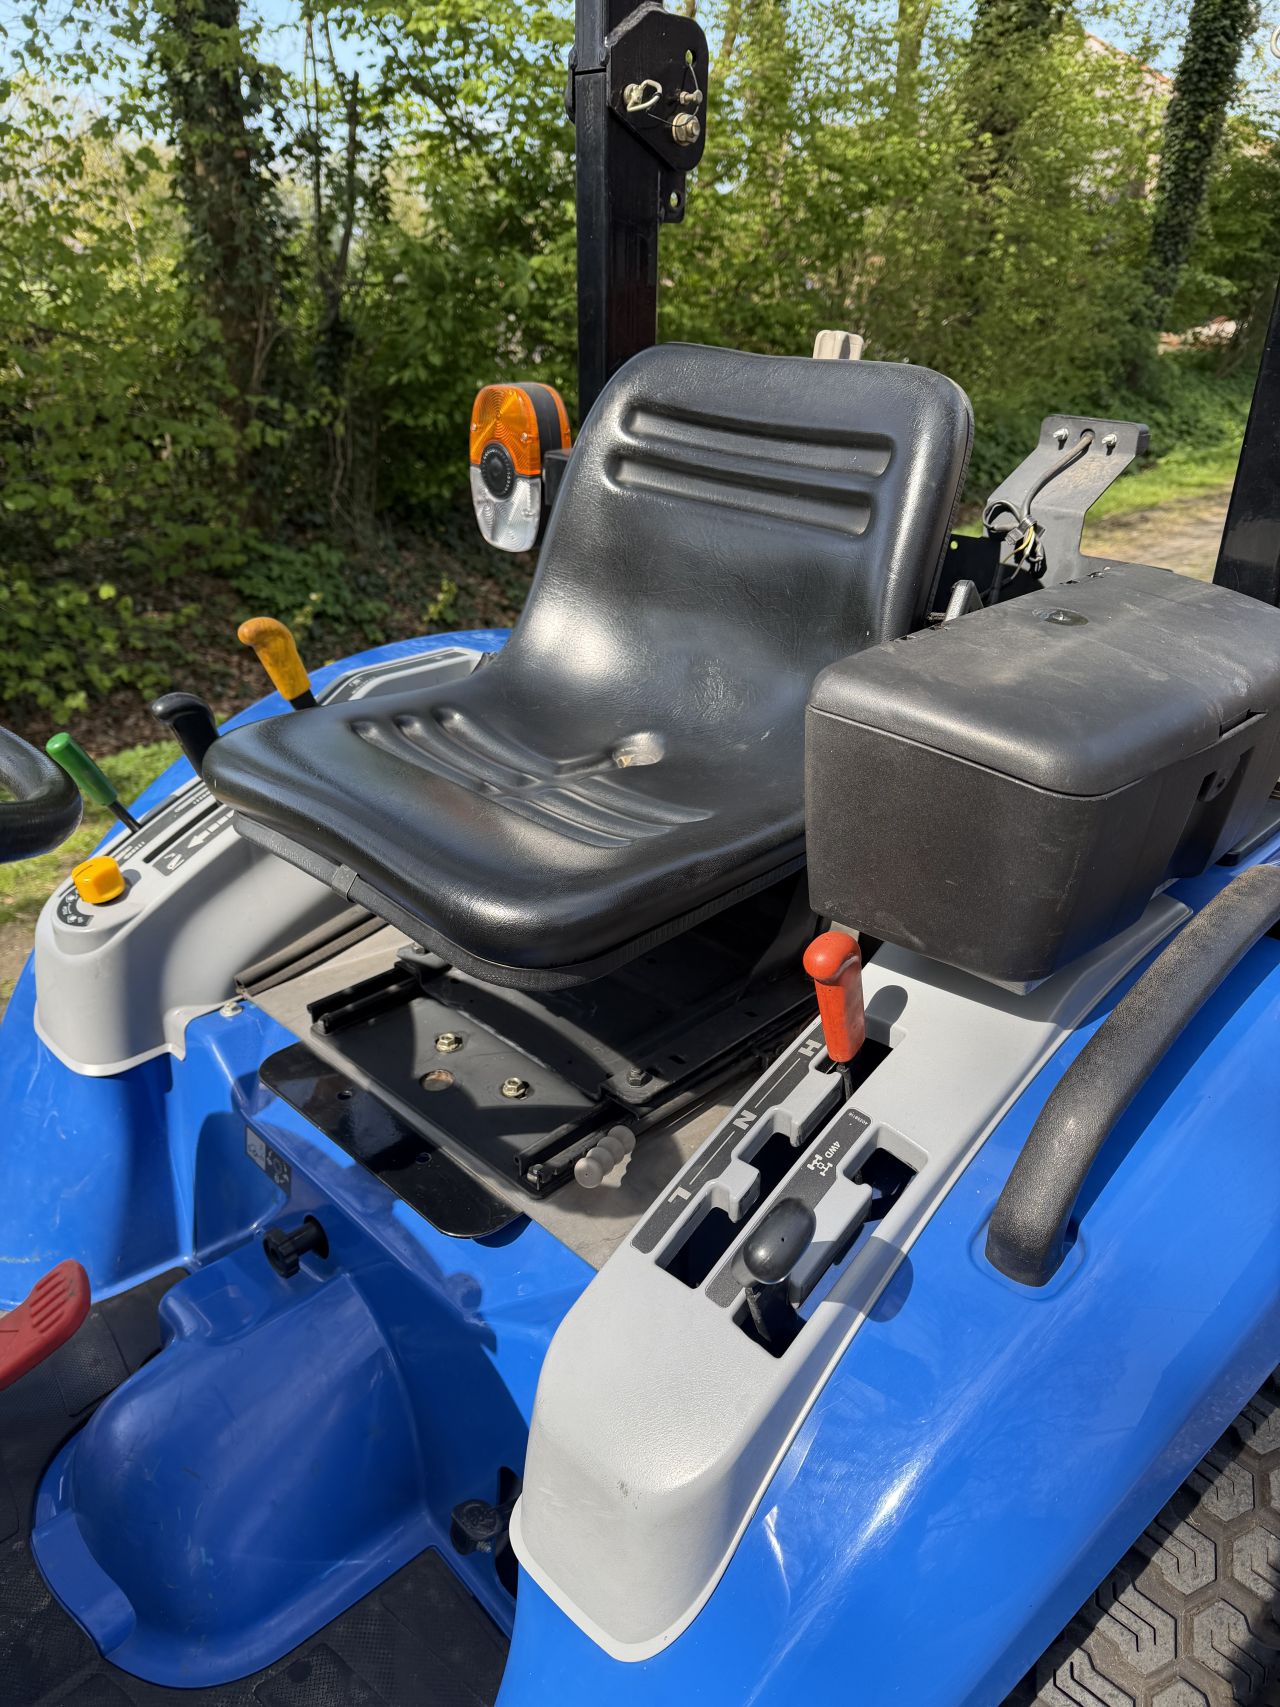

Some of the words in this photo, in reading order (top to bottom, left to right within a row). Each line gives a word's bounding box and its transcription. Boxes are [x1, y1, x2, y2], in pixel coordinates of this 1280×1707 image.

[798, 1039, 822, 1057] H
[732, 1109, 757, 1131] N
[825, 1141, 840, 1158] 4WD
[667, 1186, 692, 1203] L
